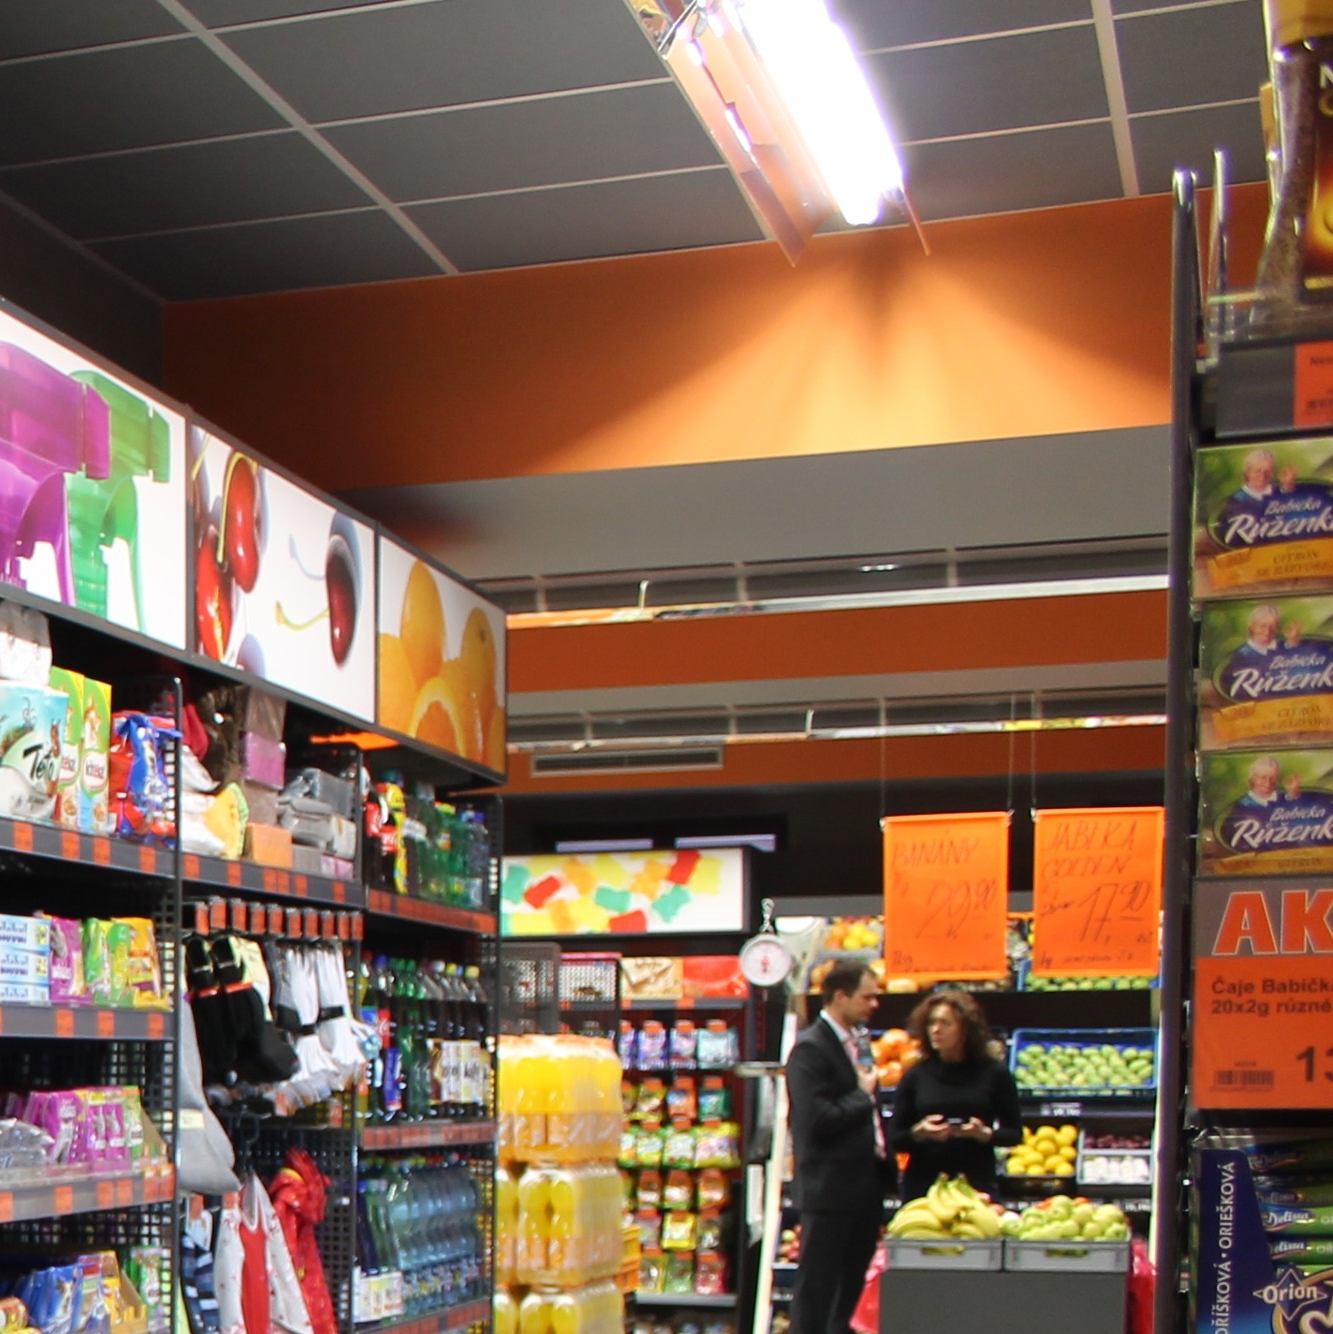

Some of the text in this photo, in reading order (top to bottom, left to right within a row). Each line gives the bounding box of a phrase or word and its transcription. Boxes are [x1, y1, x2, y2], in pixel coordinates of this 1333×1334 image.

[1211, 996, 1332, 1017] 20x2g různé
[1215, 1161, 1237, 1250] ORIEŠKOVÁ
[1262, 1280, 1319, 1304] Orion
